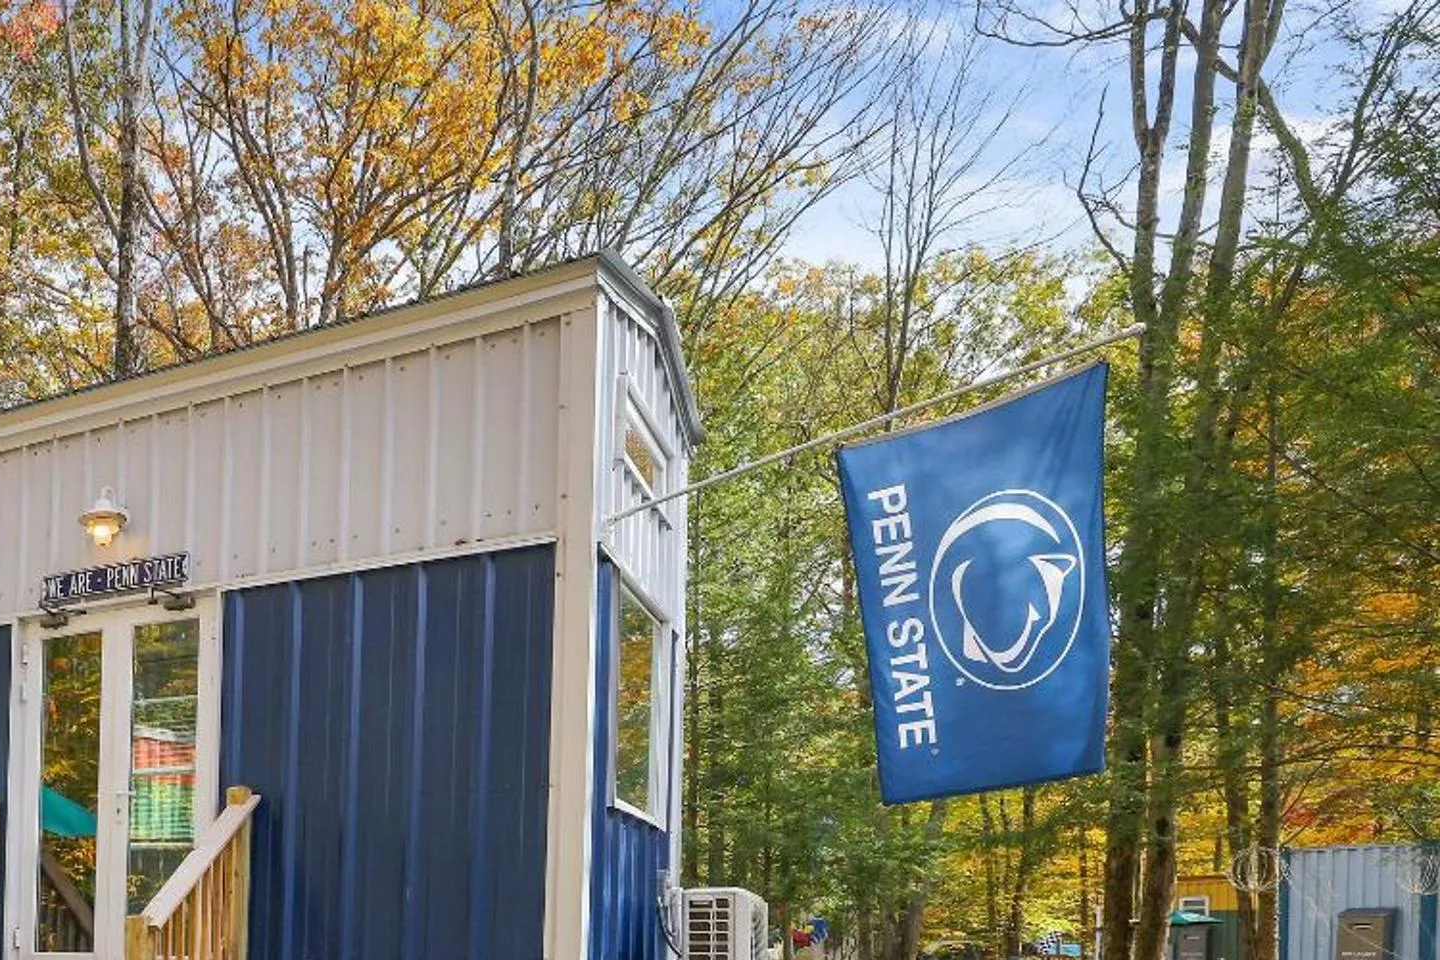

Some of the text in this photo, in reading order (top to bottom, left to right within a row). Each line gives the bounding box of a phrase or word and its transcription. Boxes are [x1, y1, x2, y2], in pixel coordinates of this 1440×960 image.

[49, 576, 64, 599] WE
[70, 572, 92, 595] ARE
[106, 566, 139, 588] PENN
[143, 557, 181, 583] STATE
[867, 484, 937, 749] PENN STATE
